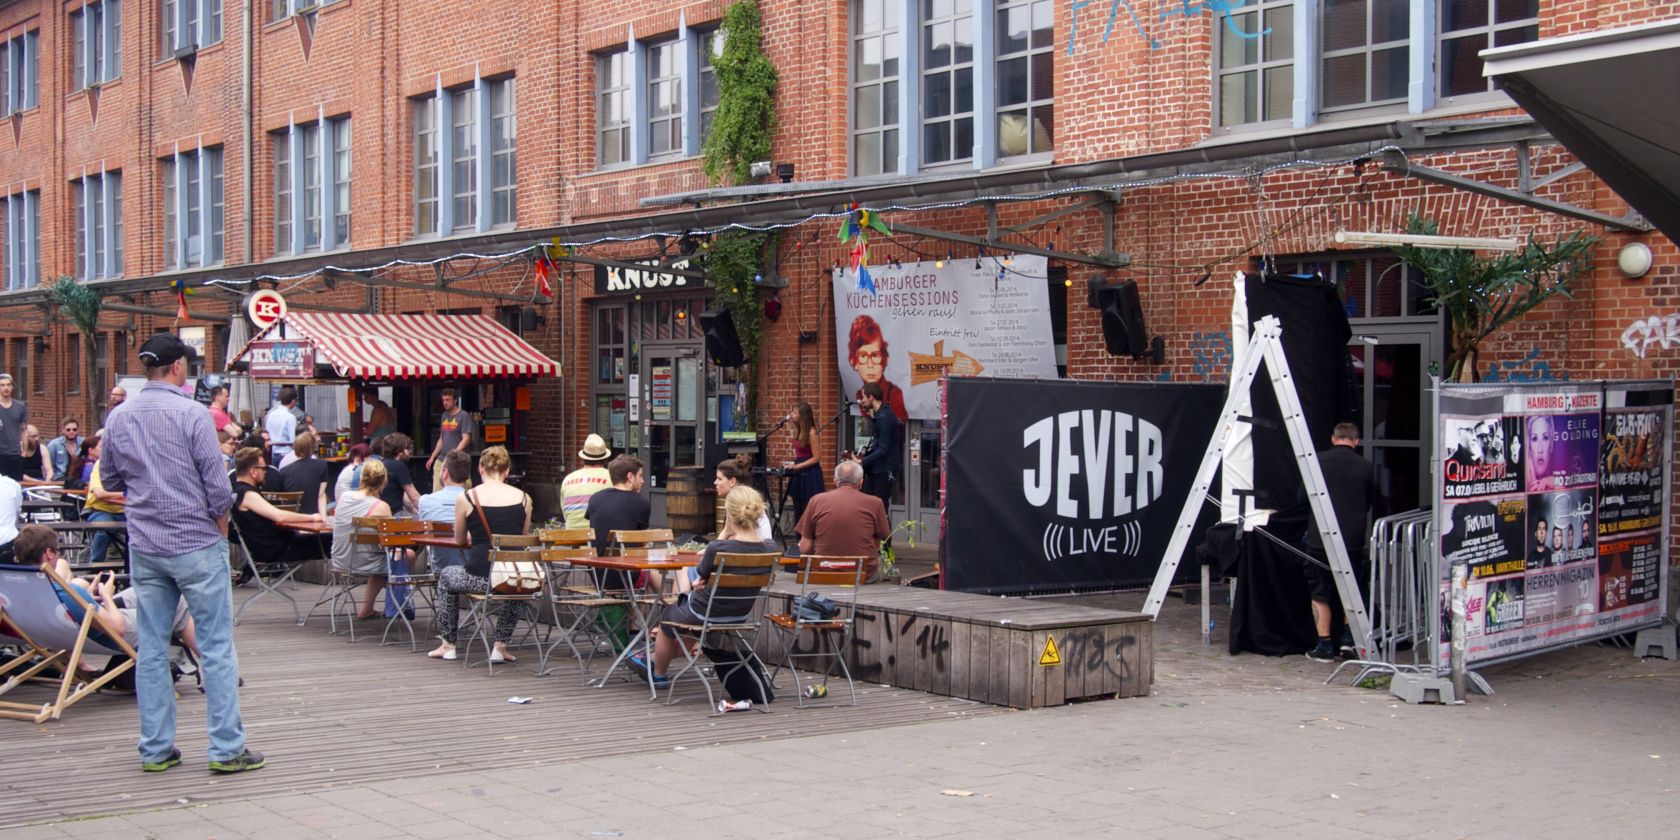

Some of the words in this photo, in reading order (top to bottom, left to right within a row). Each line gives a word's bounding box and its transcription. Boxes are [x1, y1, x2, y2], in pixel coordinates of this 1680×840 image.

[606, 259, 689, 291] KNUST
[863, 274, 937, 292] AMBURGER
[846, 290, 959, 309] KÜCHENSESSIONS
[257, 301, 279, 318] K
[892, 305, 926, 319] gehen
[928, 306, 957, 319] raus!
[929, 327, 961, 337] Eintritt
[1526, 395, 1564, 411] HAMBURG
[1023, 409, 1164, 519] JEVER
[1445, 485, 1455, 497] SA
[1455, 483, 1472, 497] 07.0
[1526, 567, 1596, 591] HERRENMAGAZIN
